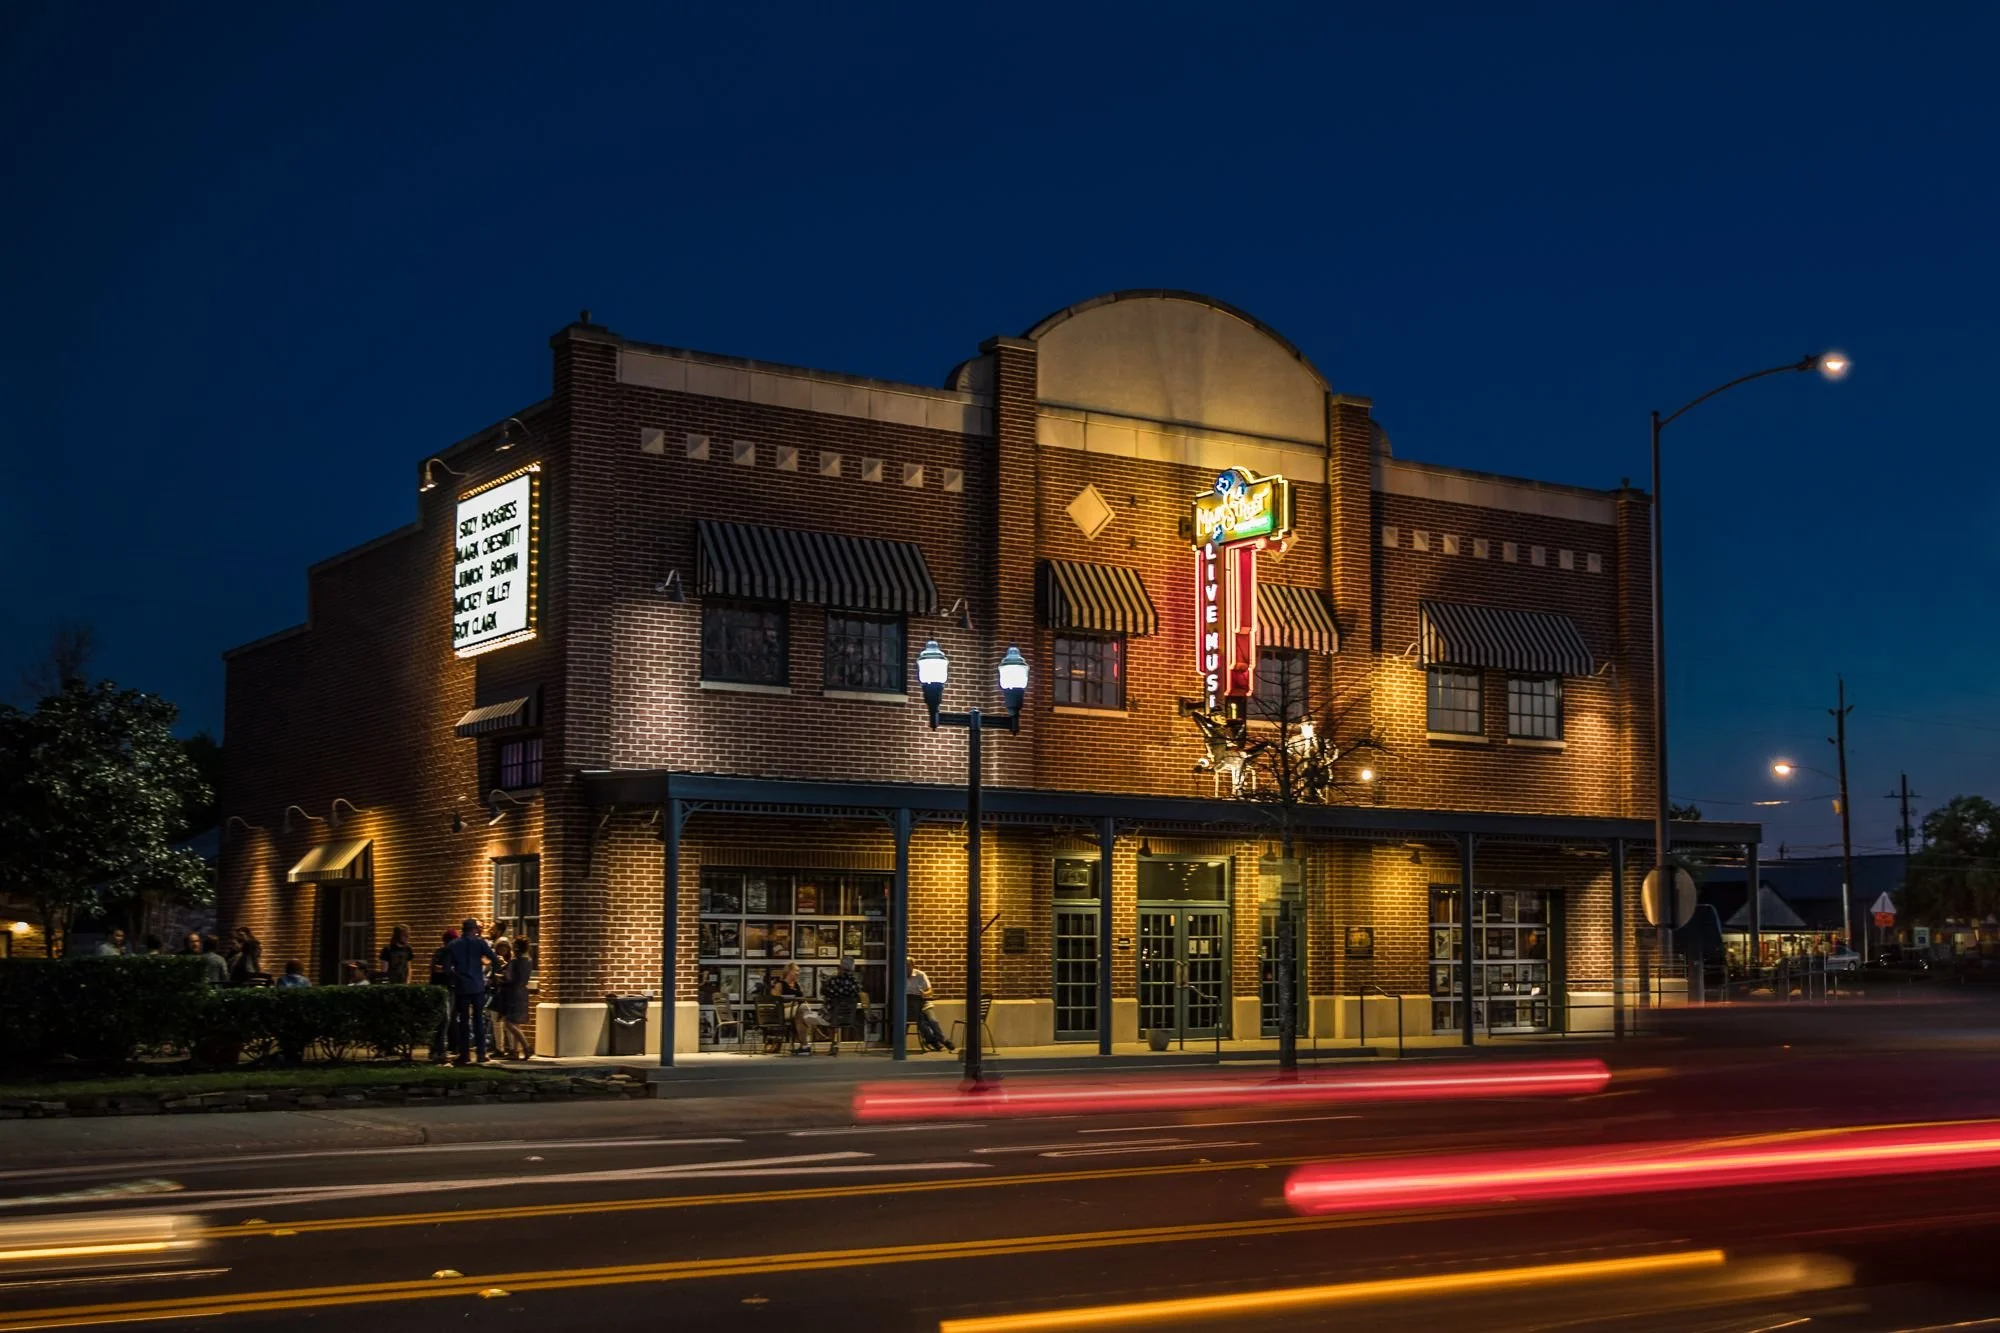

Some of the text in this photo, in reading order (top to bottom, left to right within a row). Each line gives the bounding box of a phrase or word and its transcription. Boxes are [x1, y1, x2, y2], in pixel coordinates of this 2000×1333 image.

[455, 611, 497, 640] ROY CLARK
[1205, 542, 1219, 709] LIVE MUSI
